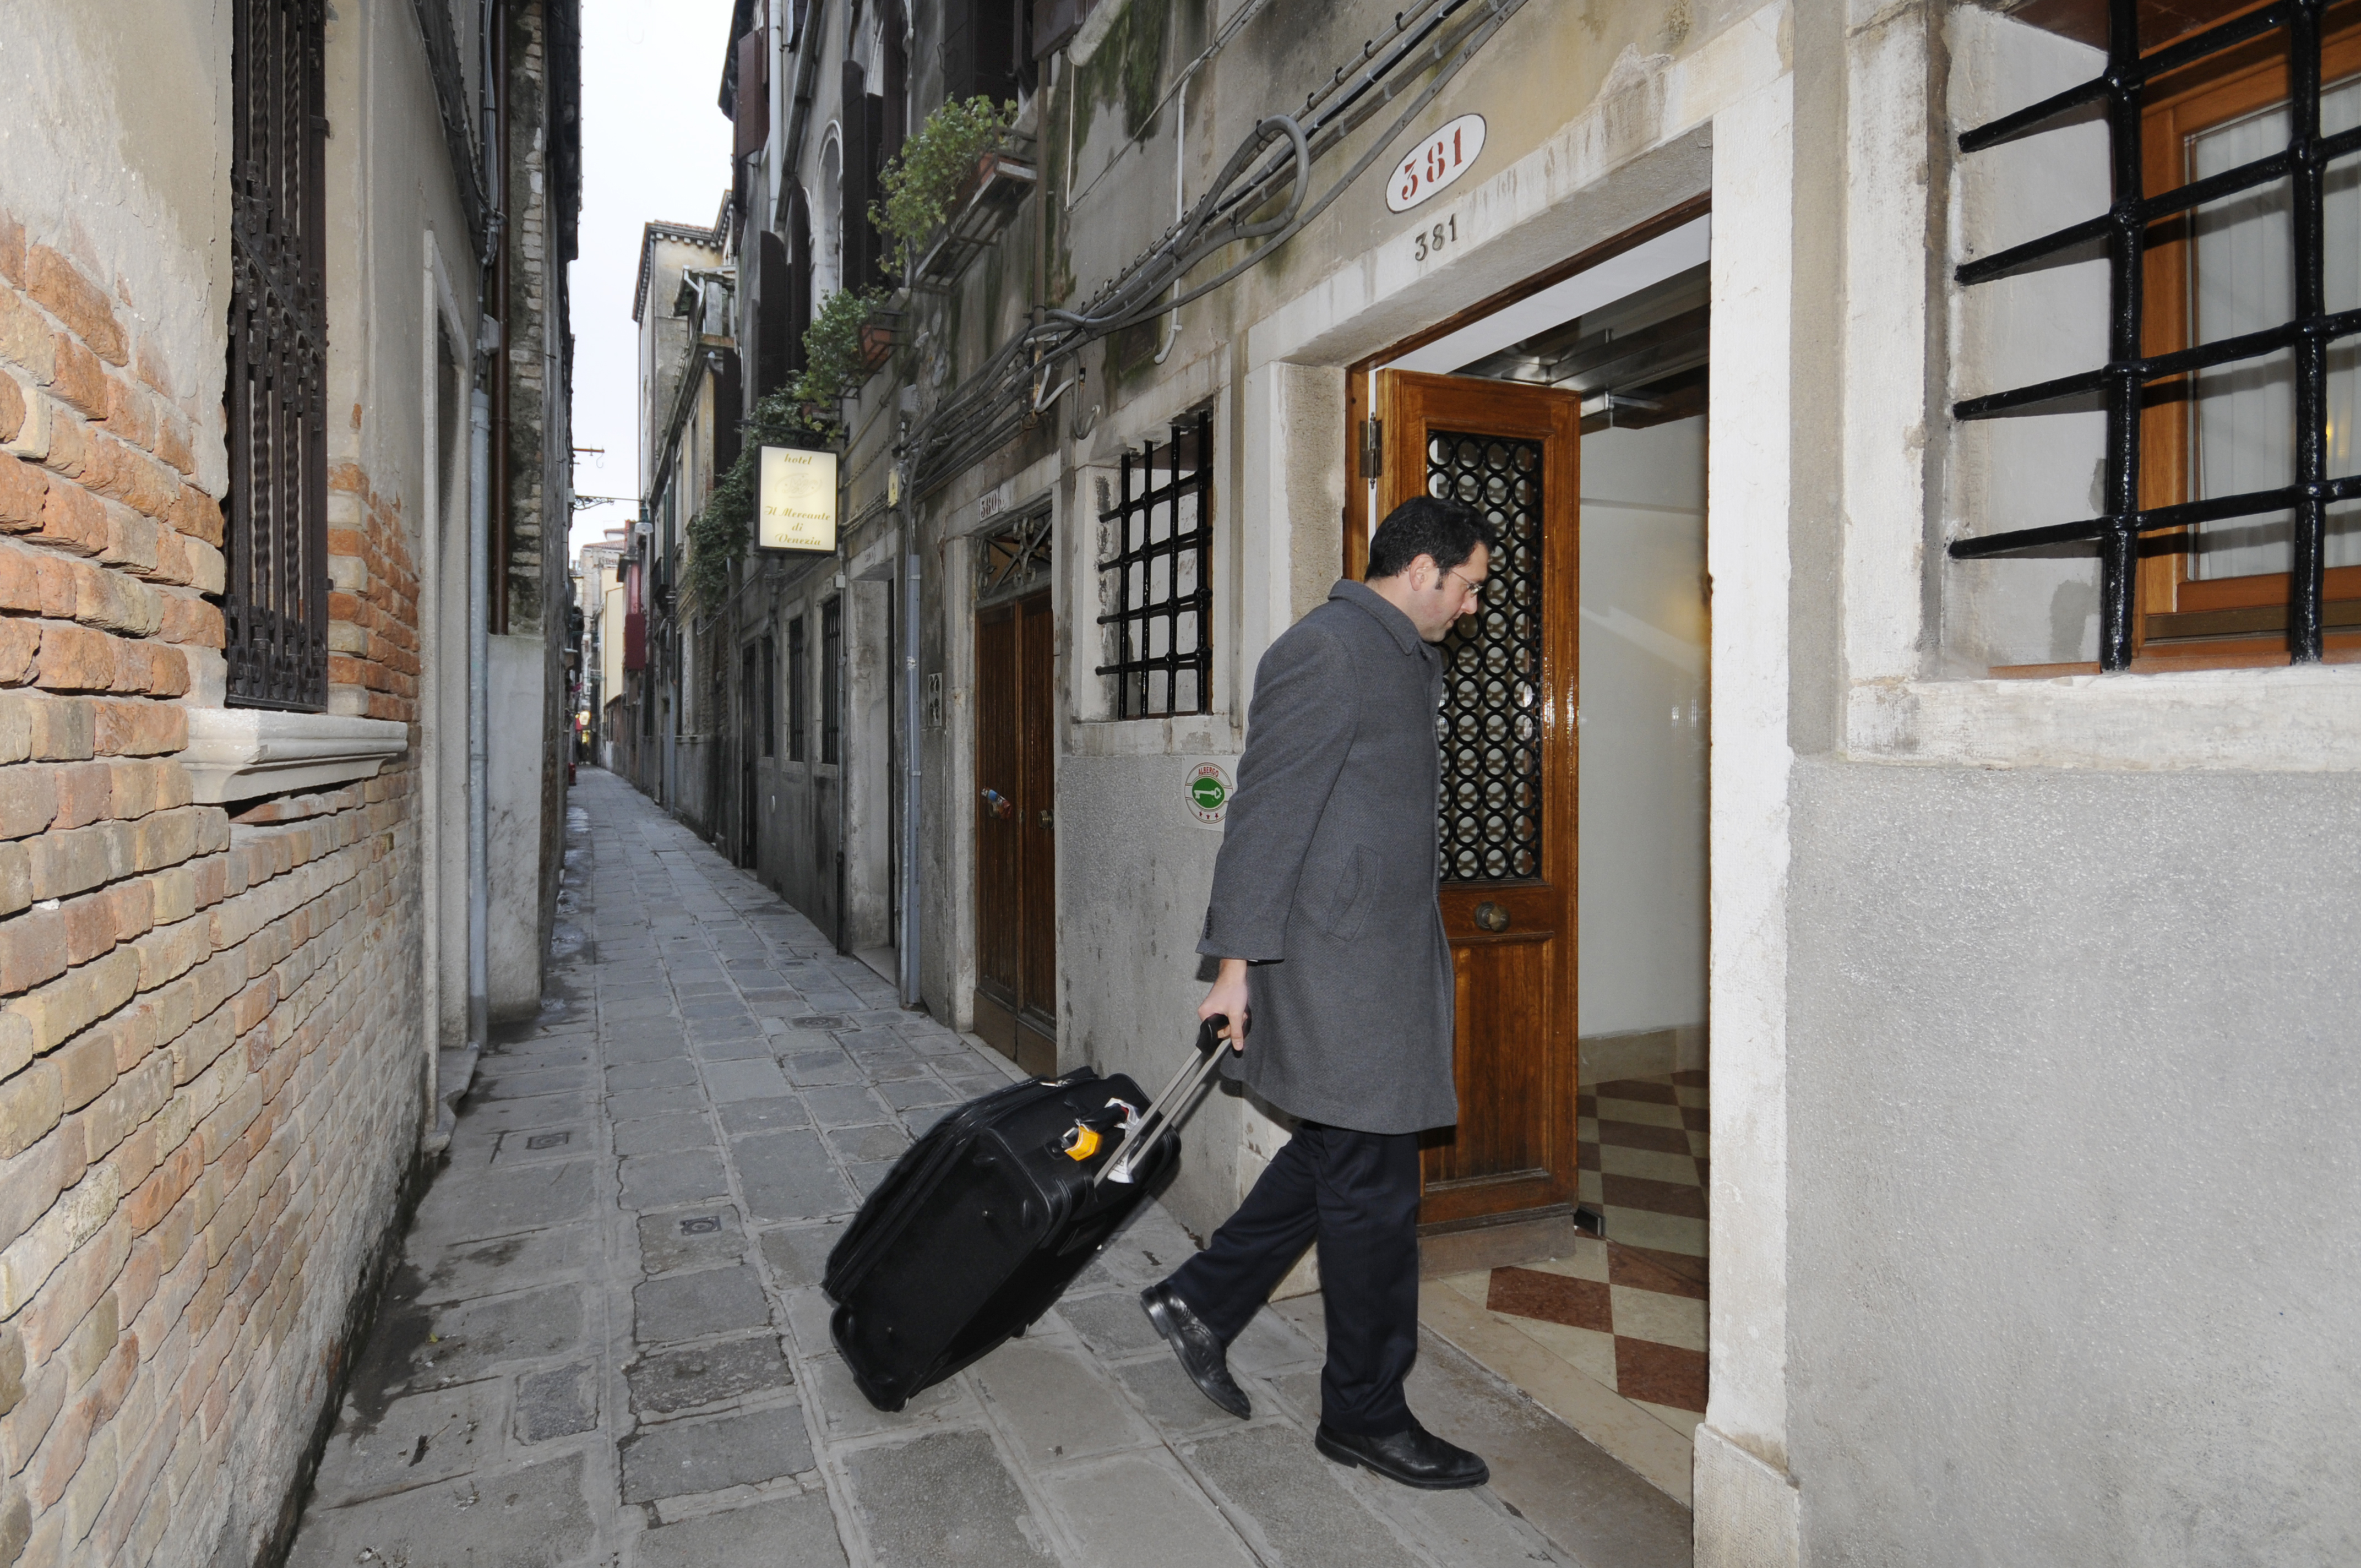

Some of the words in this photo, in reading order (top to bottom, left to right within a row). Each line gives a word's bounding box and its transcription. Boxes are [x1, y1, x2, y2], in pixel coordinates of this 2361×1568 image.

[1401, 126, 1463, 200] 381
[1415, 213, 1458, 262] 381
[784, 453, 812, 465] hotel
[764, 505, 777, 516] Il
[779, 508, 831, 521] Mercante
[981, 493, 997, 519] 380
[792, 522, 803, 532] di
[775, 533, 821, 546] Venezia
[1198, 766, 1219, 777] ALBERGO
